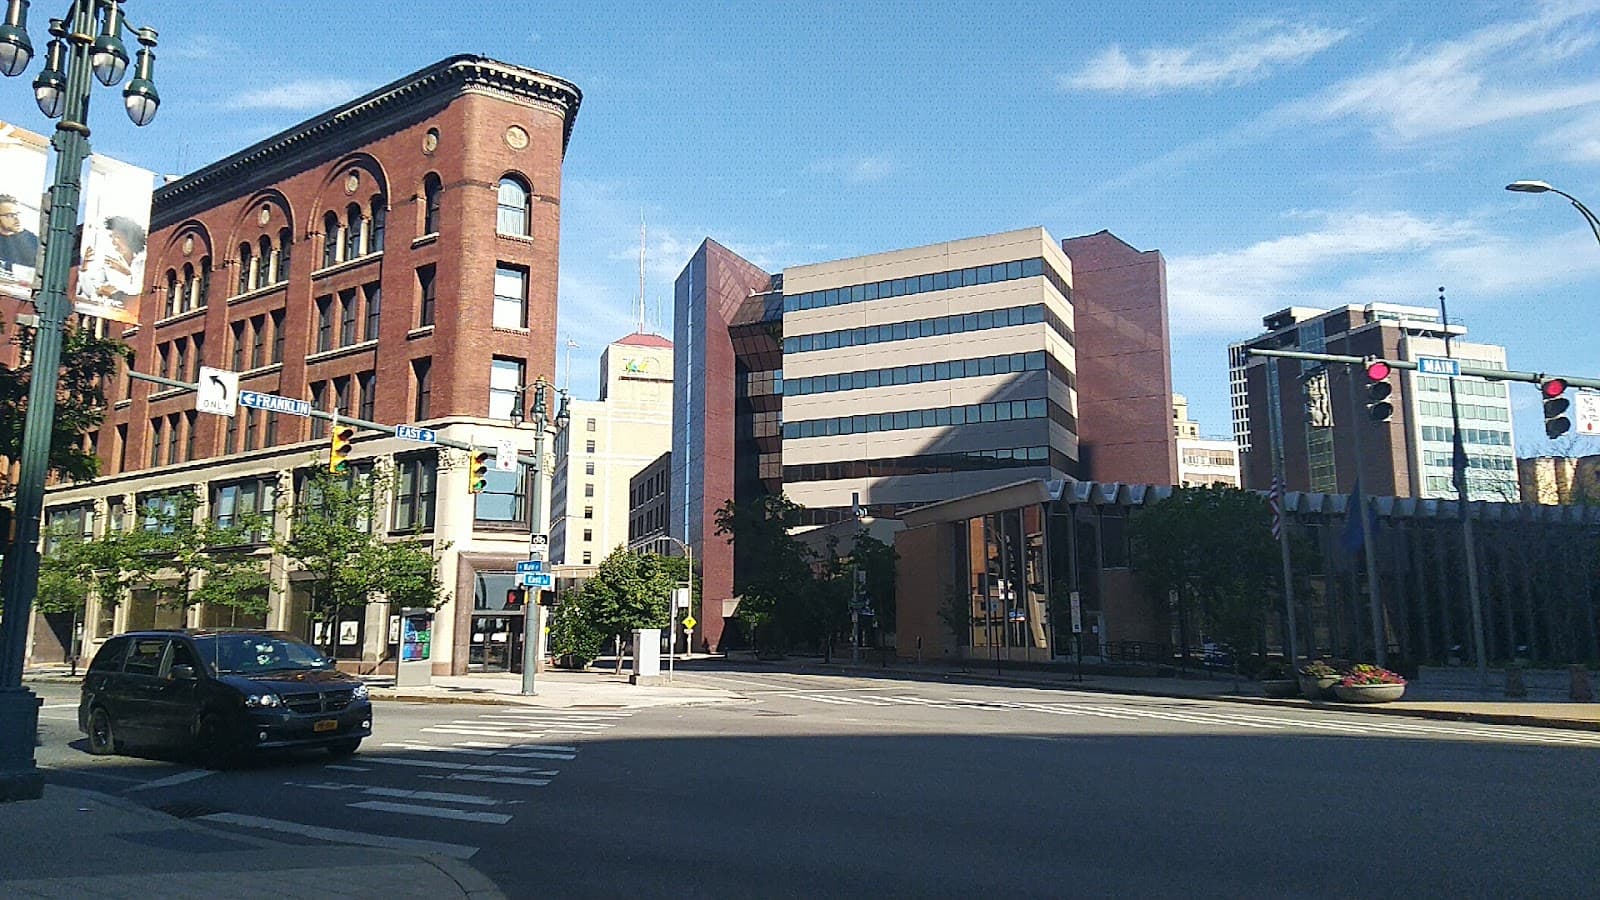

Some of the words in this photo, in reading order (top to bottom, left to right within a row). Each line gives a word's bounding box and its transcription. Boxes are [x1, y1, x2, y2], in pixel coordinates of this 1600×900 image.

[1424, 359, 1455, 374] MAIN
[203, 399, 230, 410] ONLY
[256, 395, 309, 415] FRANKLIN
[399, 426, 420, 439] EAST
